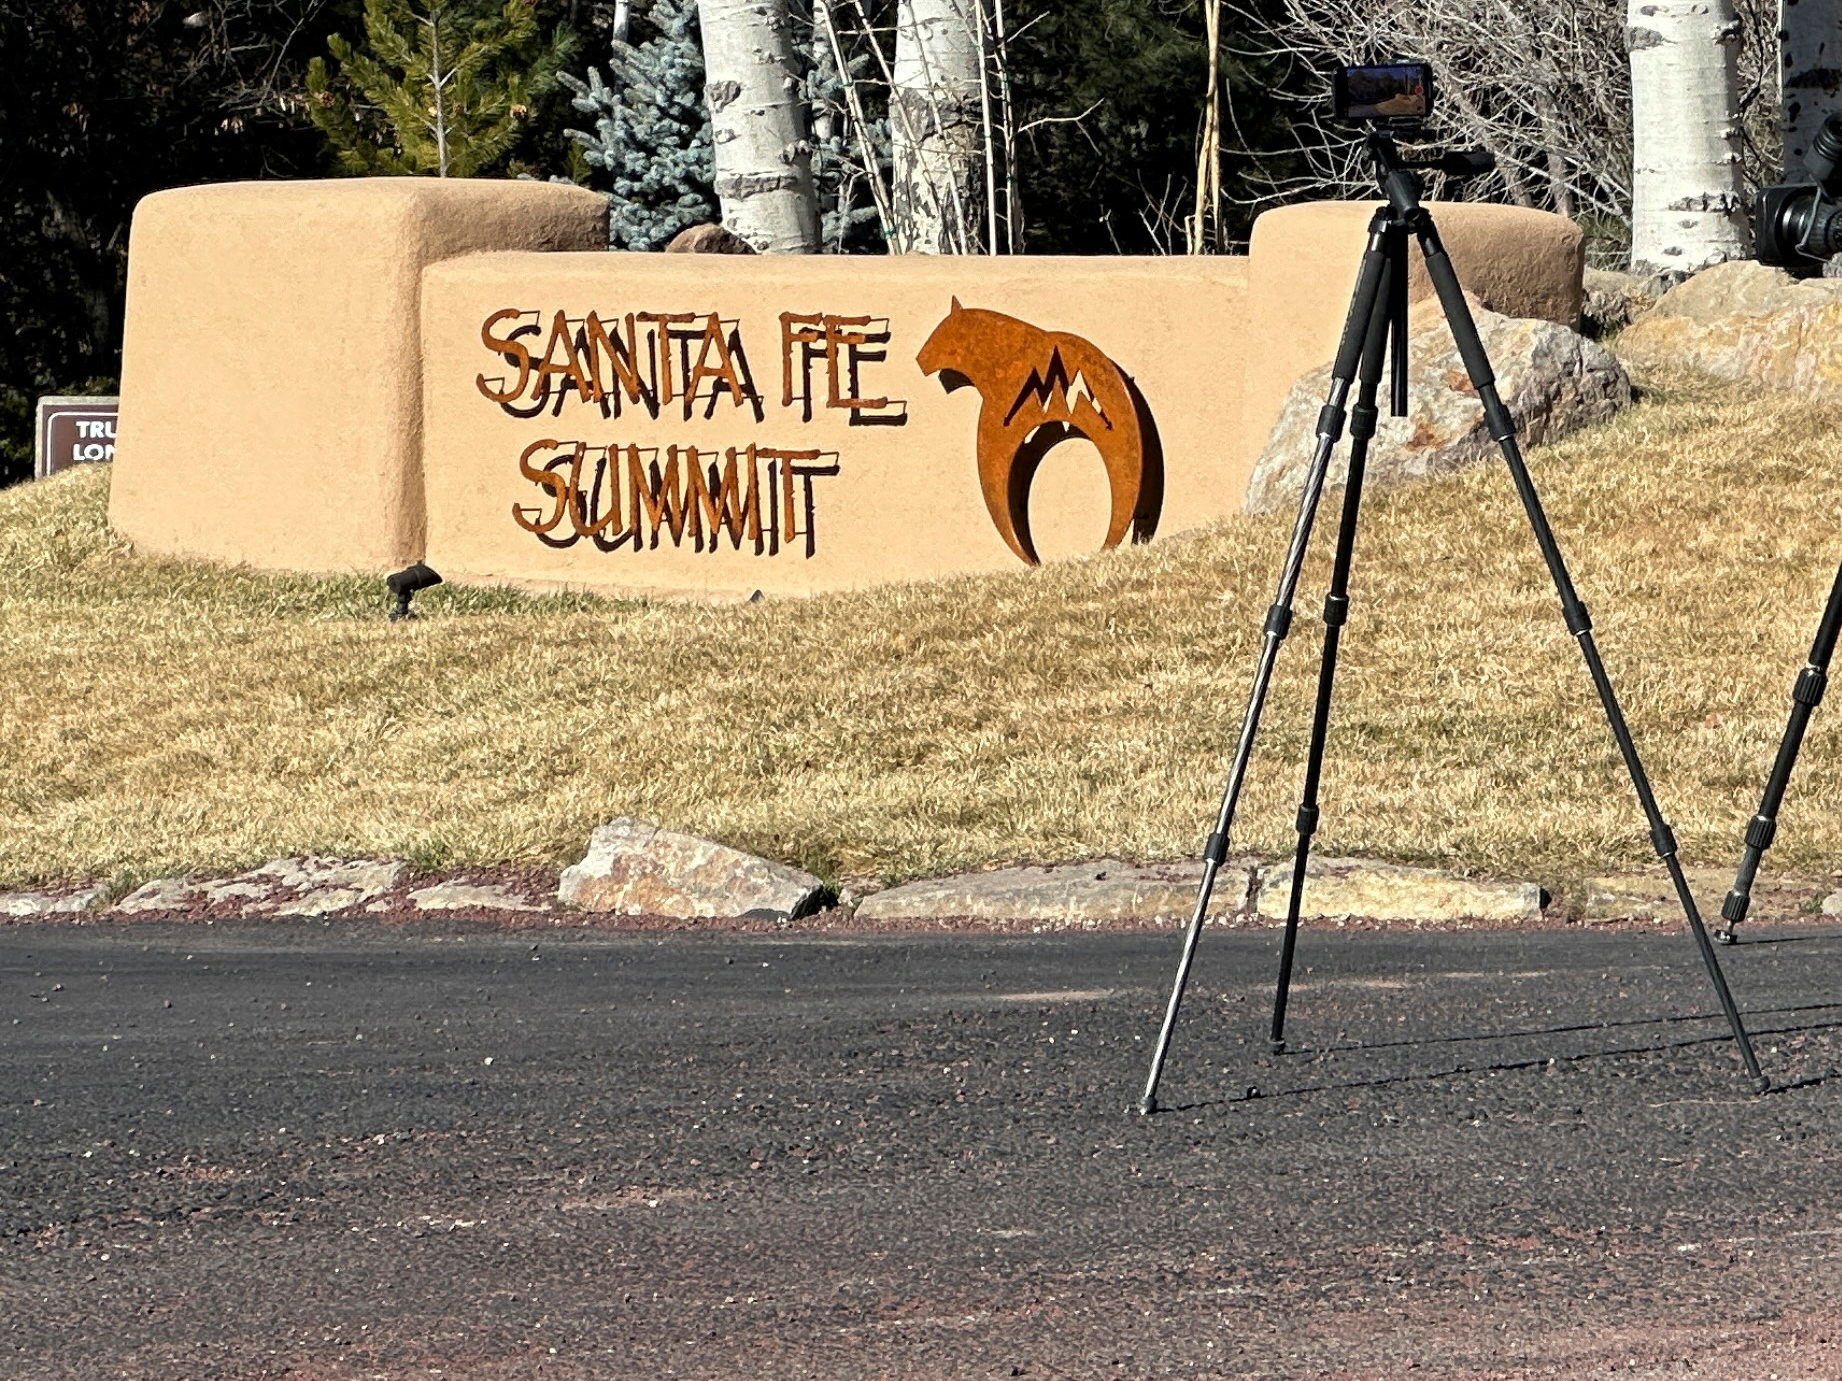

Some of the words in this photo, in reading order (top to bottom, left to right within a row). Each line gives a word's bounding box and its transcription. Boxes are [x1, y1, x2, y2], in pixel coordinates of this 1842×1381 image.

[476, 308, 744, 407] SANTA
[778, 311, 889, 409] FE
[511, 439, 821, 544] SUMMIT
